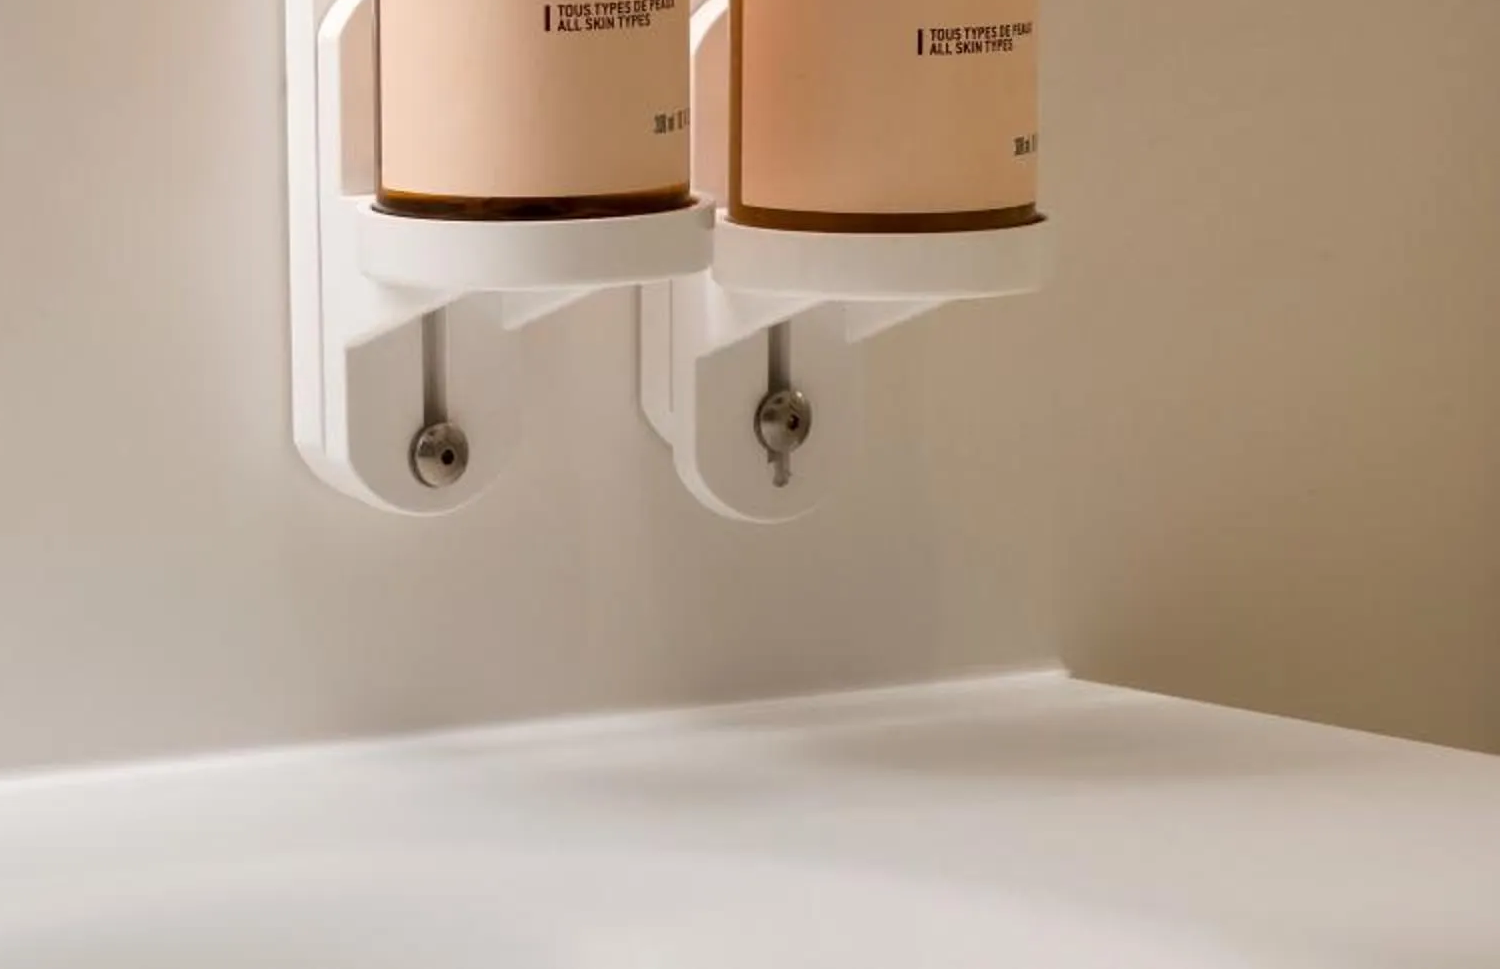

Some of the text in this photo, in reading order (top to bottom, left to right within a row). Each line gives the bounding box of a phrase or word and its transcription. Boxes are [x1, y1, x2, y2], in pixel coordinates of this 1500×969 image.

[557, 3, 591, 17] TOUS
[595, 0, 631, 15] TYPES
[557, 13, 651, 32] ALL SKIN TYPES
[929, 27, 961, 42] TOUS
[964, 25, 997, 40] TYPES
[999, 24, 1011, 37] DE
[929, 38, 1013, 56] ALL SKIN TYPES
